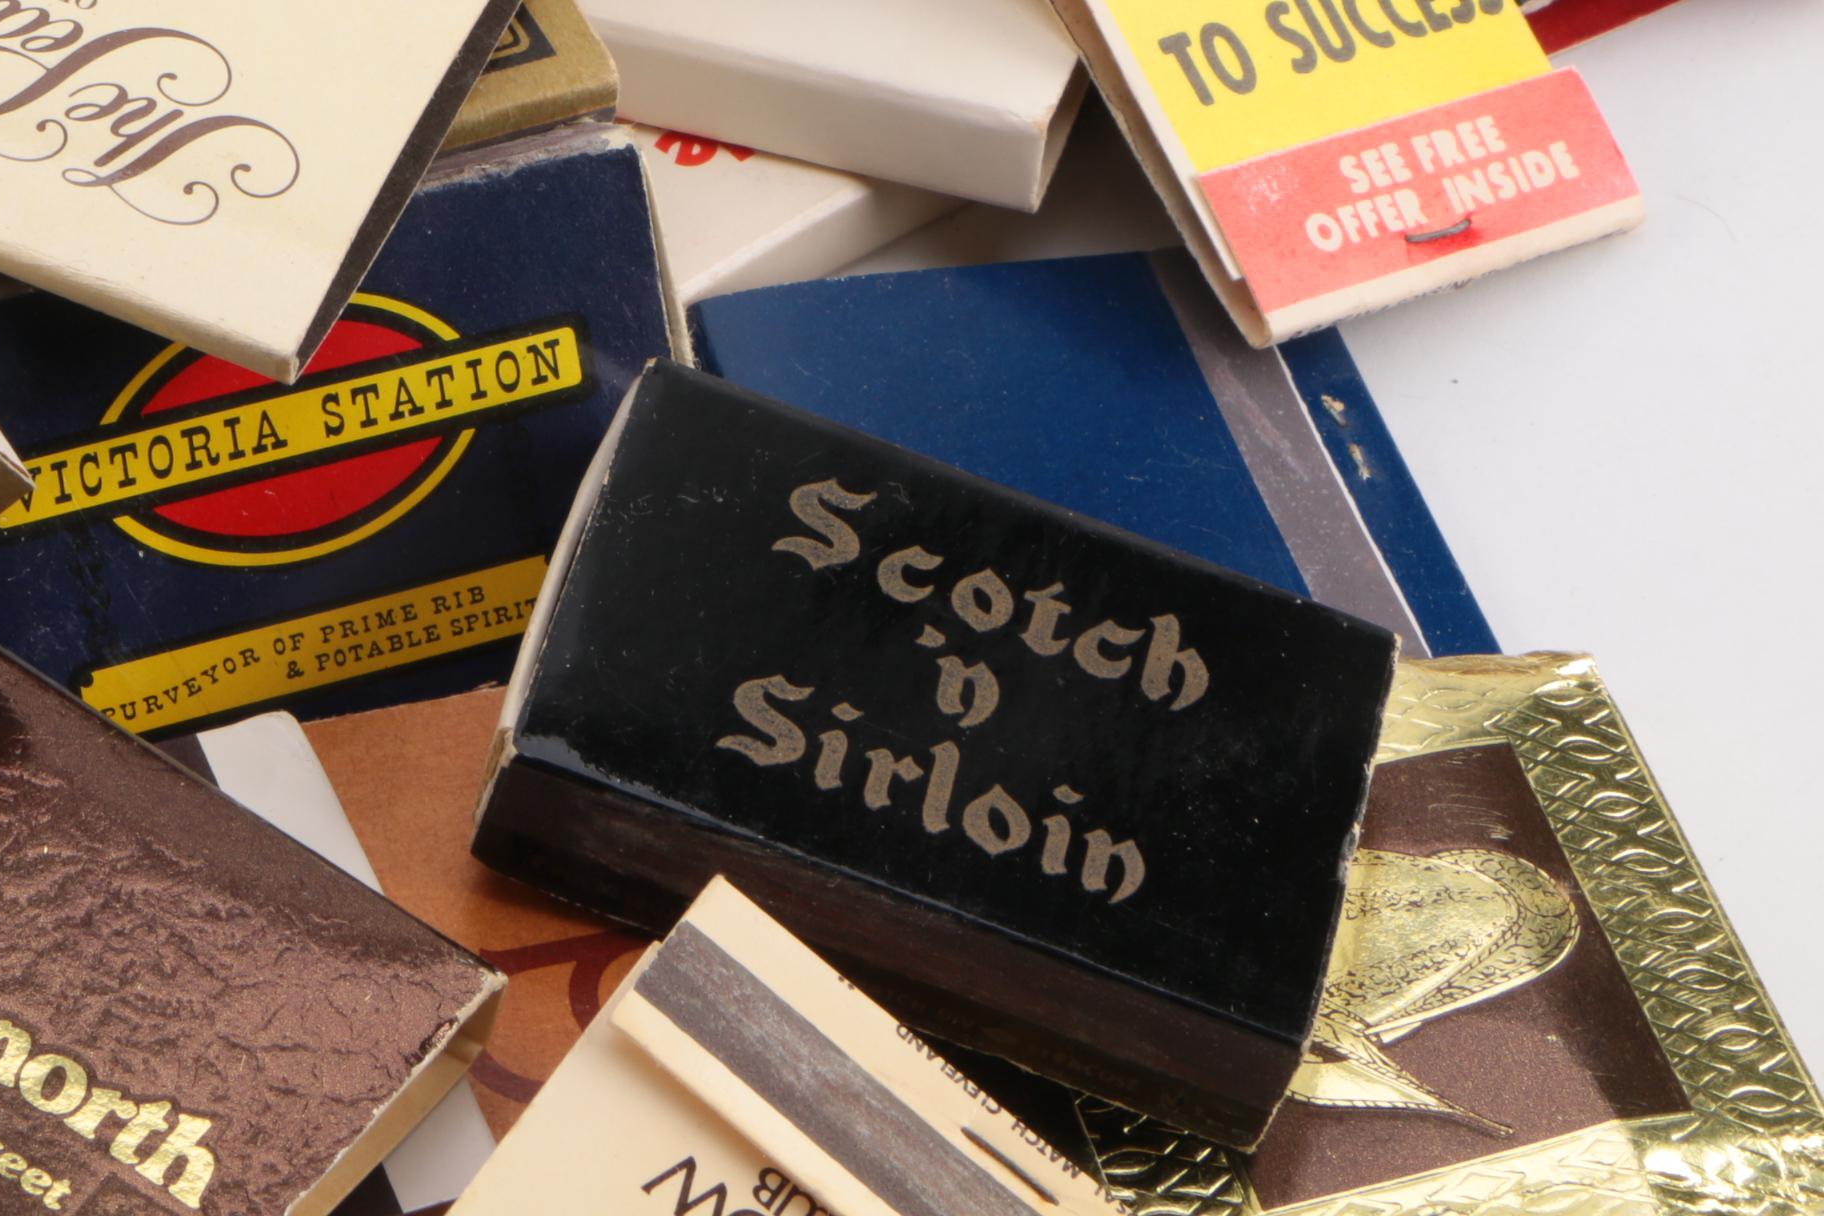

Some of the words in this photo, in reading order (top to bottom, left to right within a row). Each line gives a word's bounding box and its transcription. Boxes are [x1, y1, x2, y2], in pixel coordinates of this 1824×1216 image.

[1157, 21, 1258, 107] TO
[62, 80, 301, 226] The
[1304, 188, 1427, 253] OFFER
[1446, 140, 1580, 213] INSIDE
[1338, 142, 1410, 195] SEE
[1411, 115, 1508, 174] FREE
[18, 408, 288, 515] VICTORIA
[320, 337, 566, 440] STATION
[272, 630, 307, 657] OF
[317, 602, 420, 647] PRIME
[431, 584, 488, 615] RIB
[284, 658, 306, 680] &
[314, 624, 443, 676] POTABLE
[450, 596, 539, 638] SPIRIT
[771, 478, 1211, 712] Scotch
[916, 622, 1001, 728] 'n
[714, 674, 1146, 905] Sirloin
[1010, 1114, 1084, 1180] MATCH
